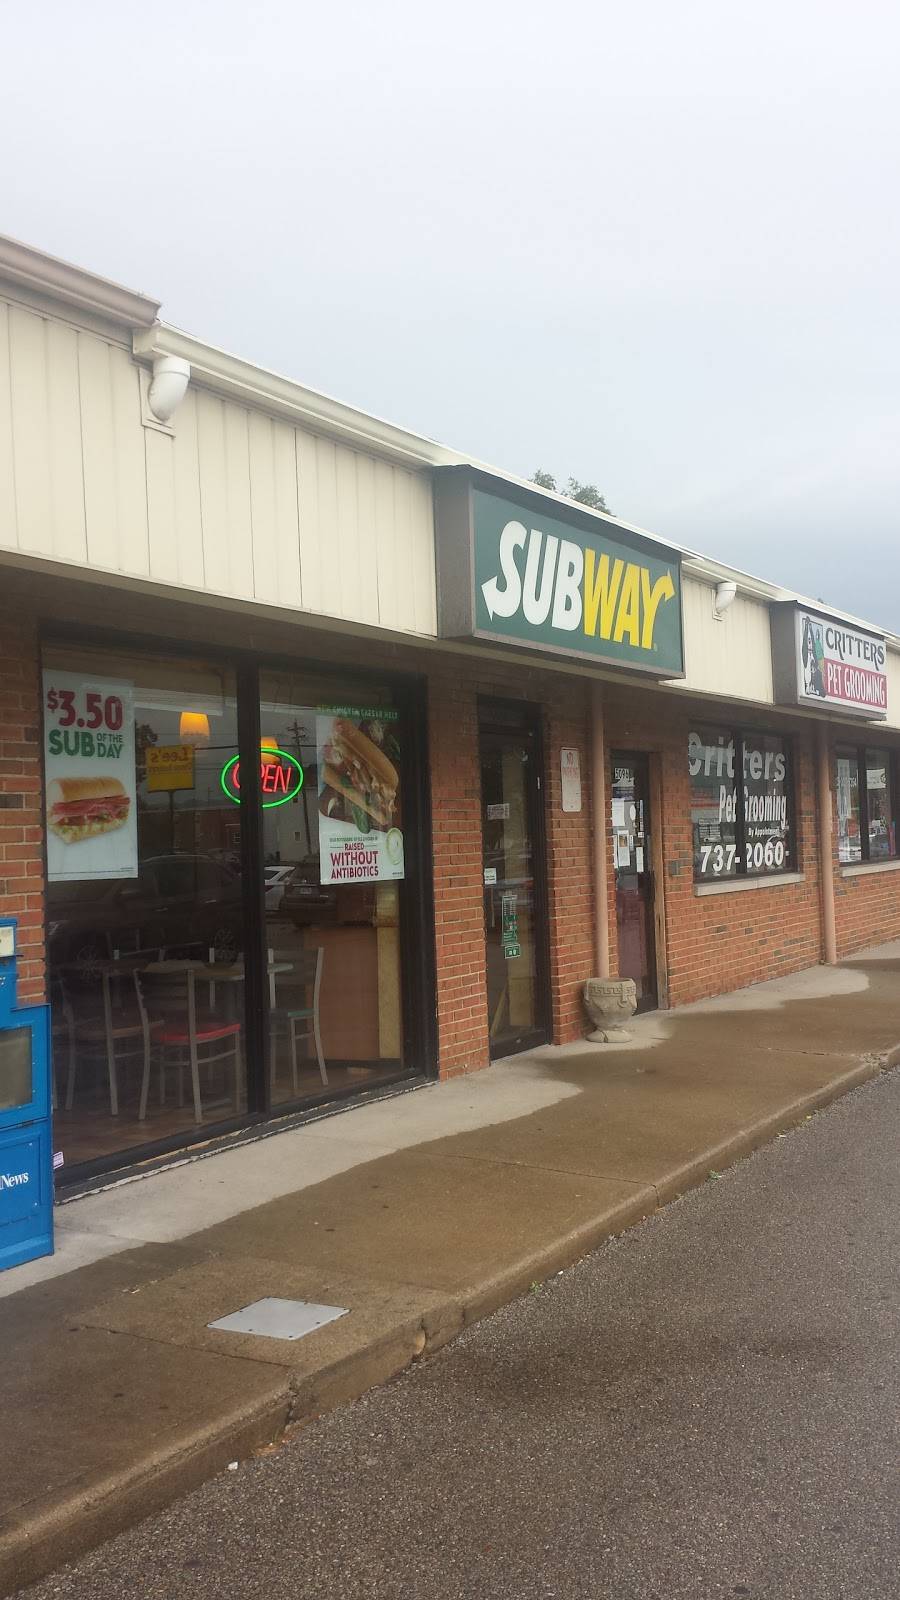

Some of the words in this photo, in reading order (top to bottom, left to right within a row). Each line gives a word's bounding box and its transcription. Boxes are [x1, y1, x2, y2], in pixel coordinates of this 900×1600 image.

[481, 520, 675, 650] SUBWAY
[825, 627, 885, 671] CRITTERS
[827, 662, 842, 696] PET
[844, 667, 885, 706] GROOMING
[47, 687, 124, 731] $3.50
[49, 729, 95, 757] SUB
[97, 732, 108, 742] OF
[109, 734, 123, 743] THE
[97, 743, 124, 759] DAY
[719, 785, 737, 823] Pet
[330, 851, 379, 867] WITHOUT
[344, 842, 365, 851] RAISED
[330, 865, 379, 880] ANTIBIOTICS
